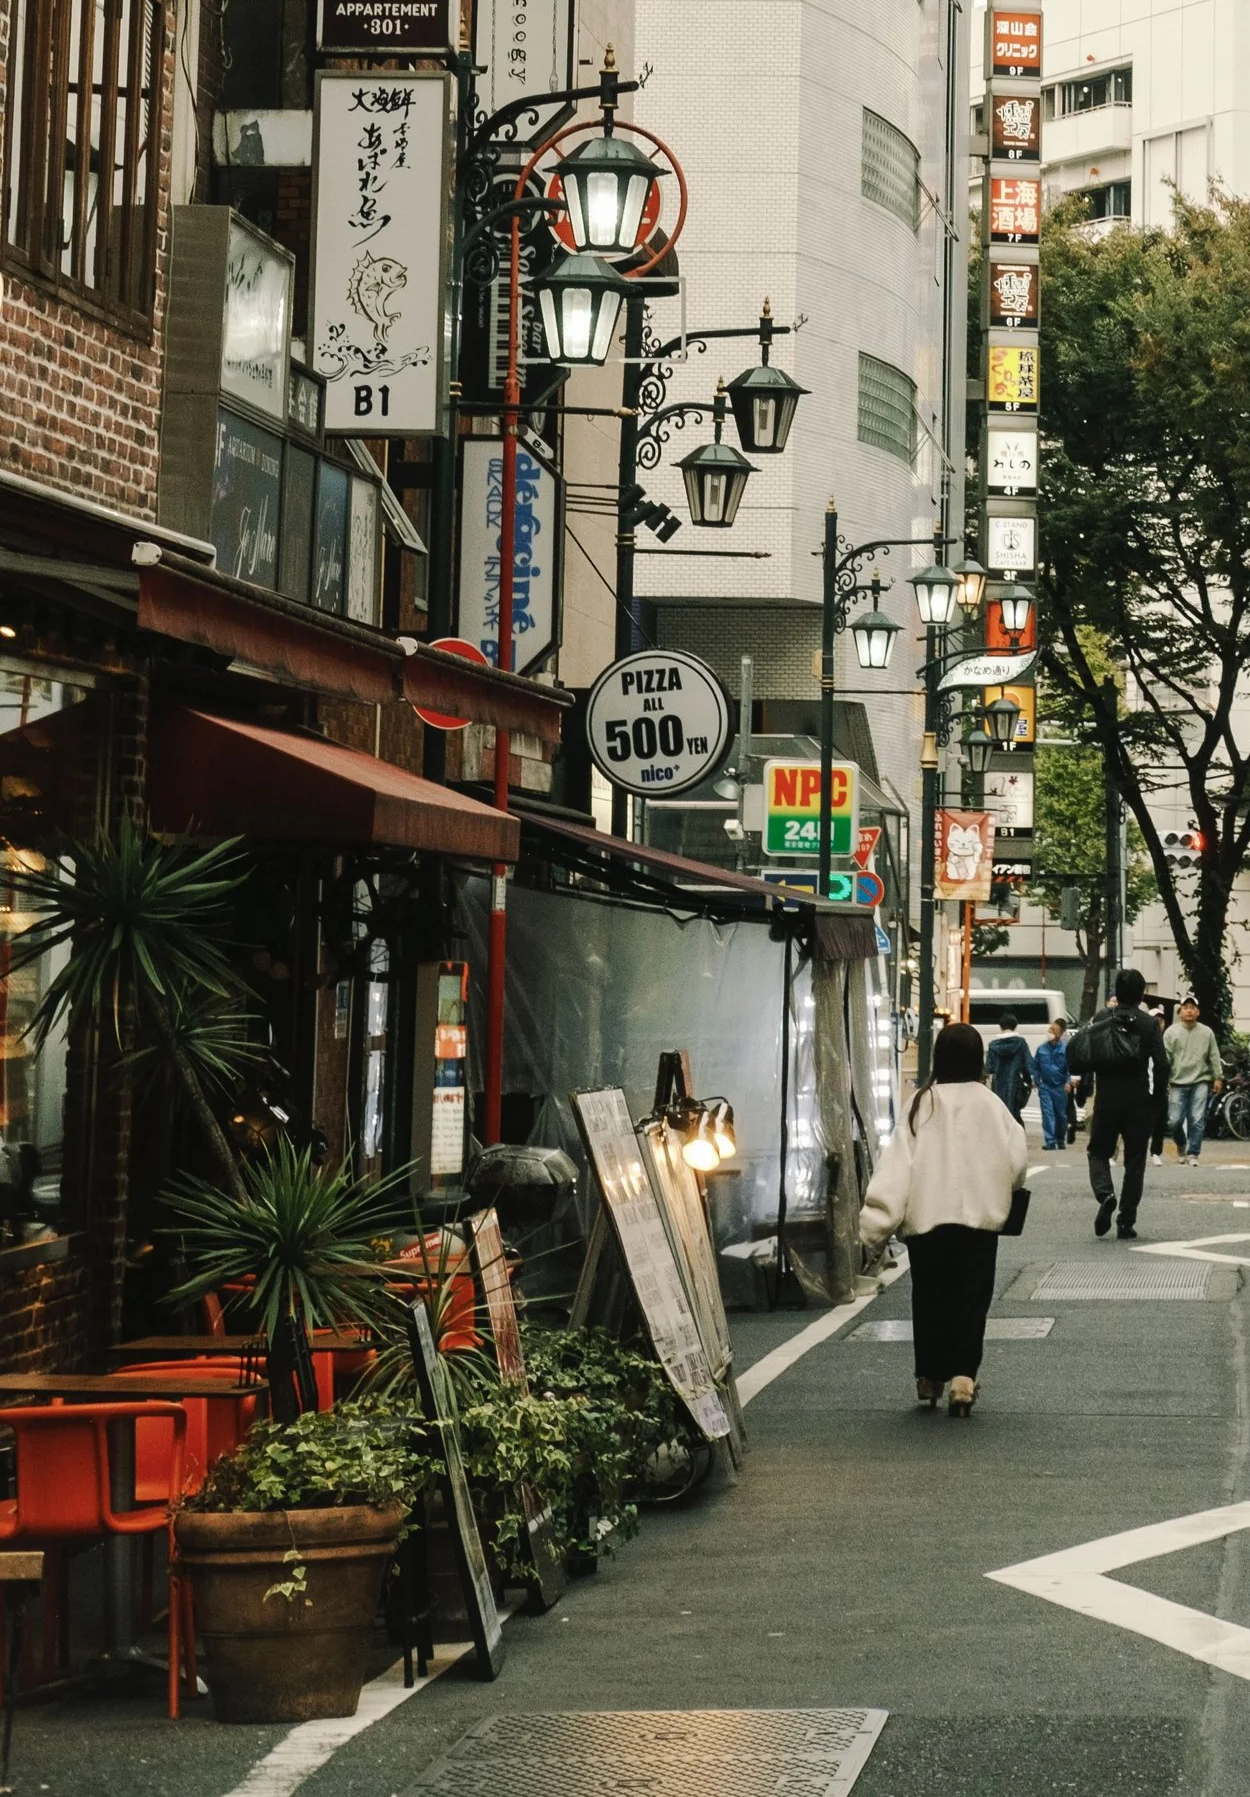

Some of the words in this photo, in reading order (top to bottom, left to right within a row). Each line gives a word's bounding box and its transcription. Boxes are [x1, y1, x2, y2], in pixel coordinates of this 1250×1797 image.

[336, 3, 438, 18] APPARTEMENT
[996, 42, 1038, 58] クリニック
[1009, 66, 1024, 76] 9F
[992, 180, 1038, 205] 上海
[992, 206, 1038, 233] 酒場
[1007, 233, 1022, 243] 7F
[1006, 317, 1021, 327] 6F
[531, 320, 544, 354] bar
[353, 384, 390, 418] B1
[1005, 401, 1021, 412] 5F
[1003, 486, 1019, 496] 4F
[995, 551, 1027, 560] SHISHA
[963, 665, 1011, 676] かなめ通り
[621, 667, 683, 696] PIZZA
[643, 697, 664, 713] ALL
[605, 714, 684, 763] 500
[686, 736, 708, 756] YEN
[1001, 741, 1017, 751] 1F
[773, 767, 847, 808] NPC
[1000, 827, 1015, 837] B1
[400, 1236, 440, 1258] Suprme
